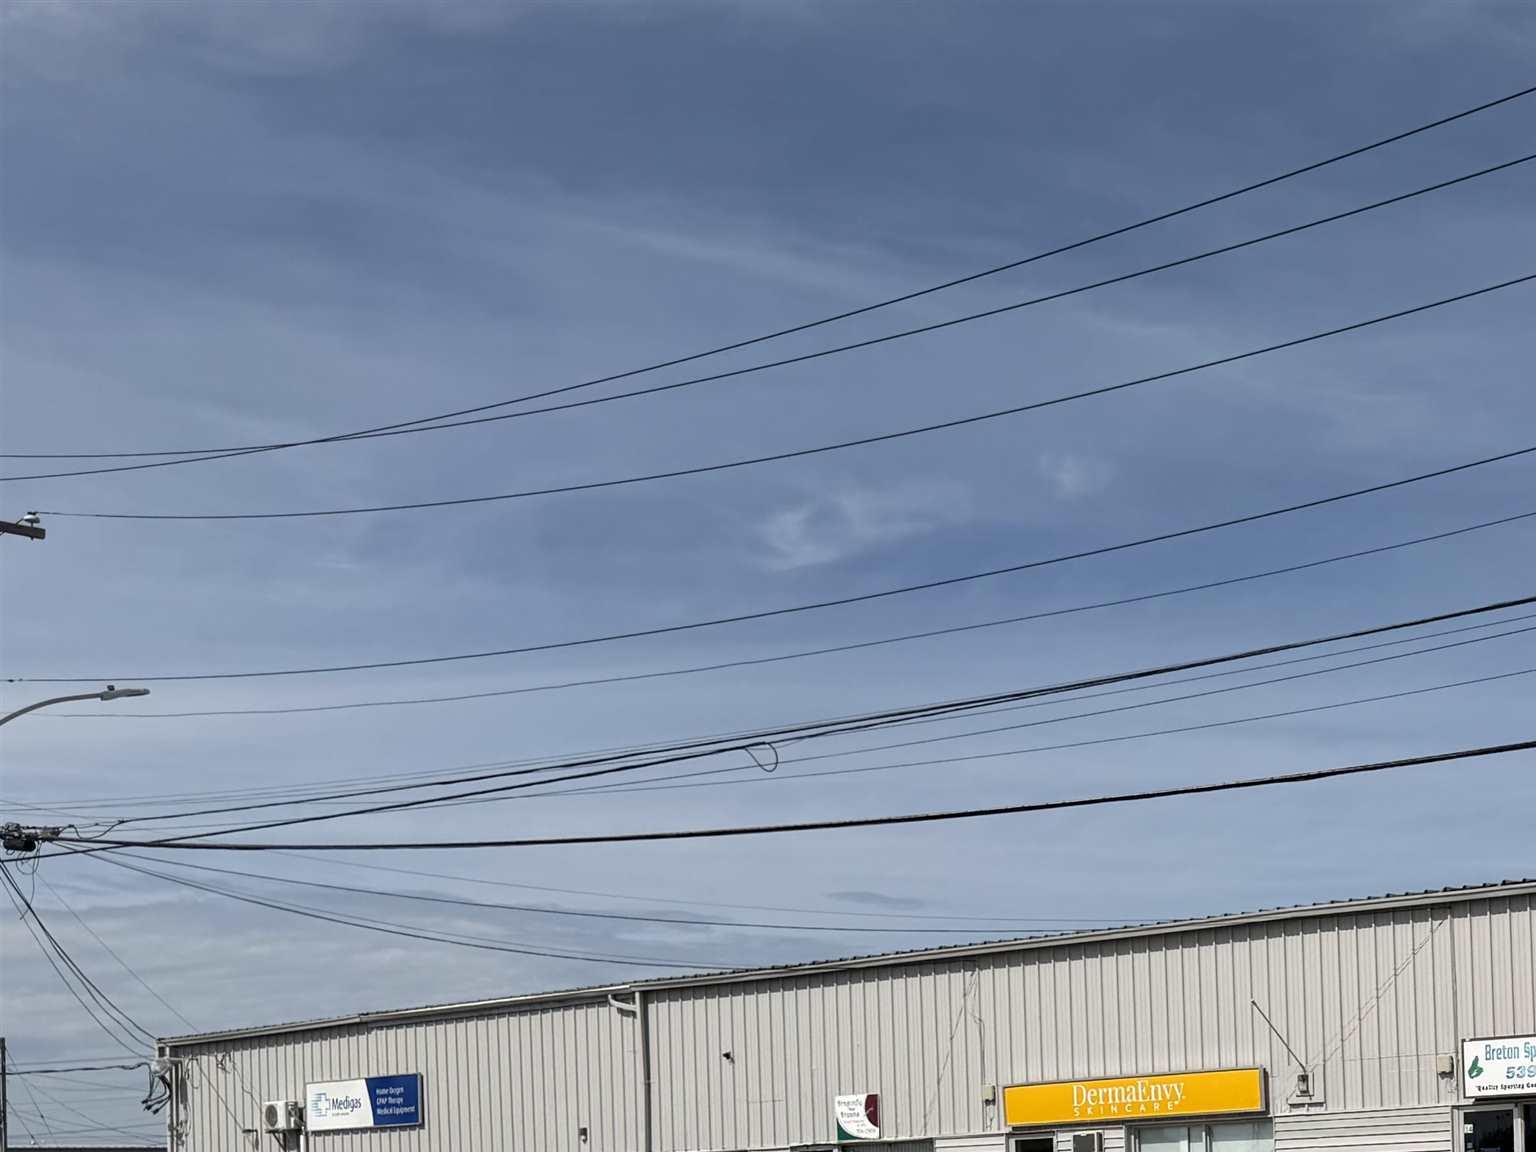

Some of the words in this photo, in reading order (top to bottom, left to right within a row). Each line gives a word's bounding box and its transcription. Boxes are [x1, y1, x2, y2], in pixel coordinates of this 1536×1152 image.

[1484, 1043, 1520, 1061] Breton
[1072, 1080, 1185, 1107] DermaEnvy
[332, 1096, 362, 1112] Medigas
[1073, 1101, 1175, 1117] SKINCARE
